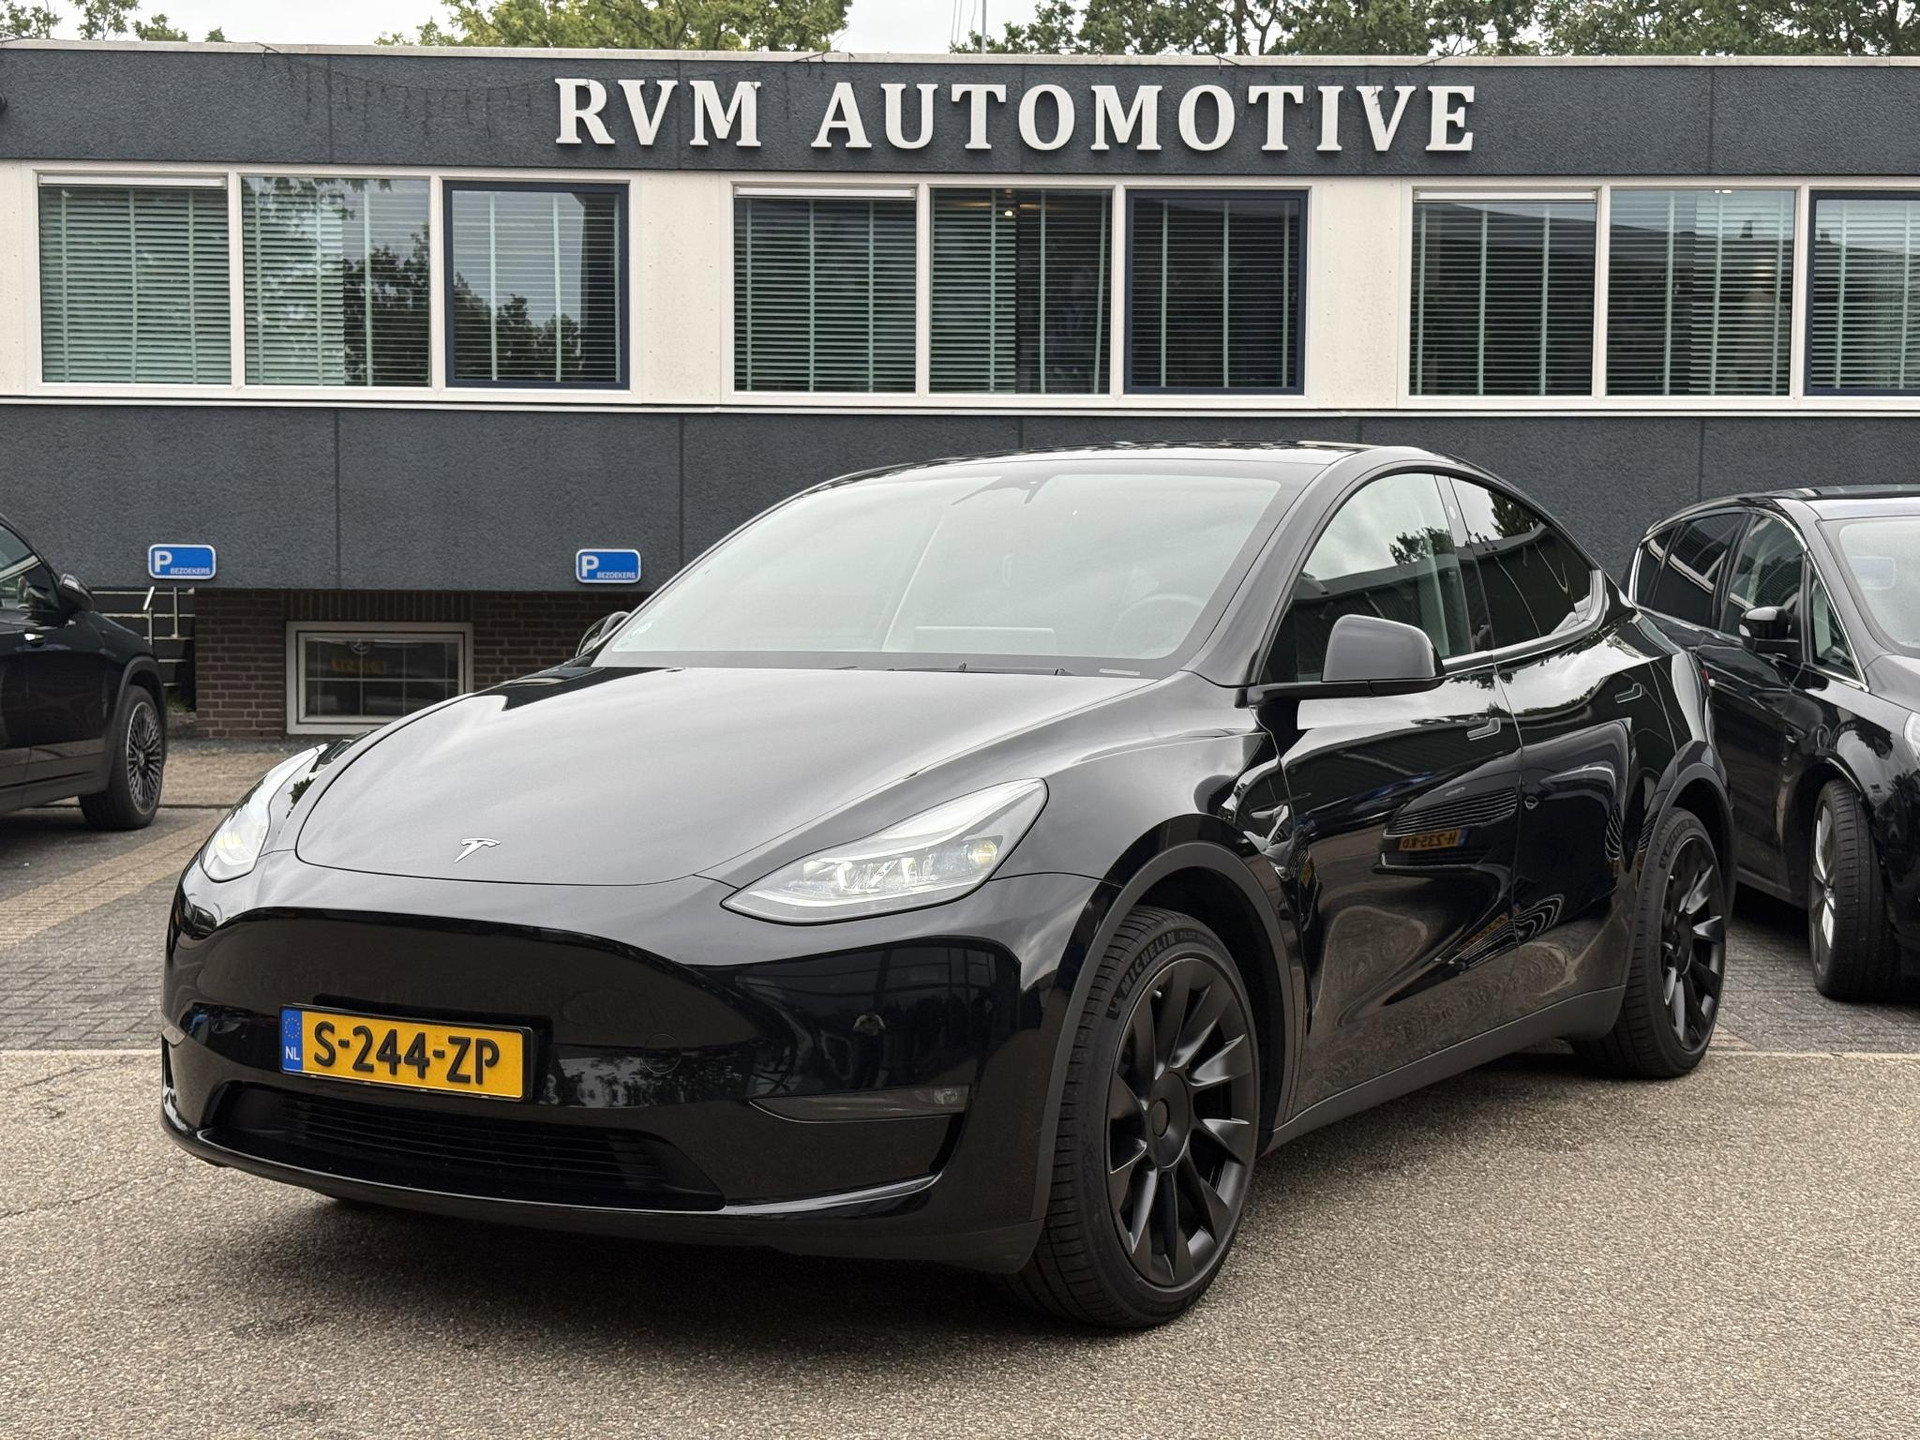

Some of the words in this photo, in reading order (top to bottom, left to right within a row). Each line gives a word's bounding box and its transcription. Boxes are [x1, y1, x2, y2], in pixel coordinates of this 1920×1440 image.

[554, 78, 762, 147] RVM
[810, 82, 1476, 152] AUTOMOTIVE
[154, 550, 173, 573] P
[170, 567, 211, 575] BEZOEKERS
[581, 554, 600, 578] P
[596, 571, 636, 579] BEZOEKERS
[285, 1045, 301, 1061] NL
[313, 1020, 501, 1086] S-244-ZP
